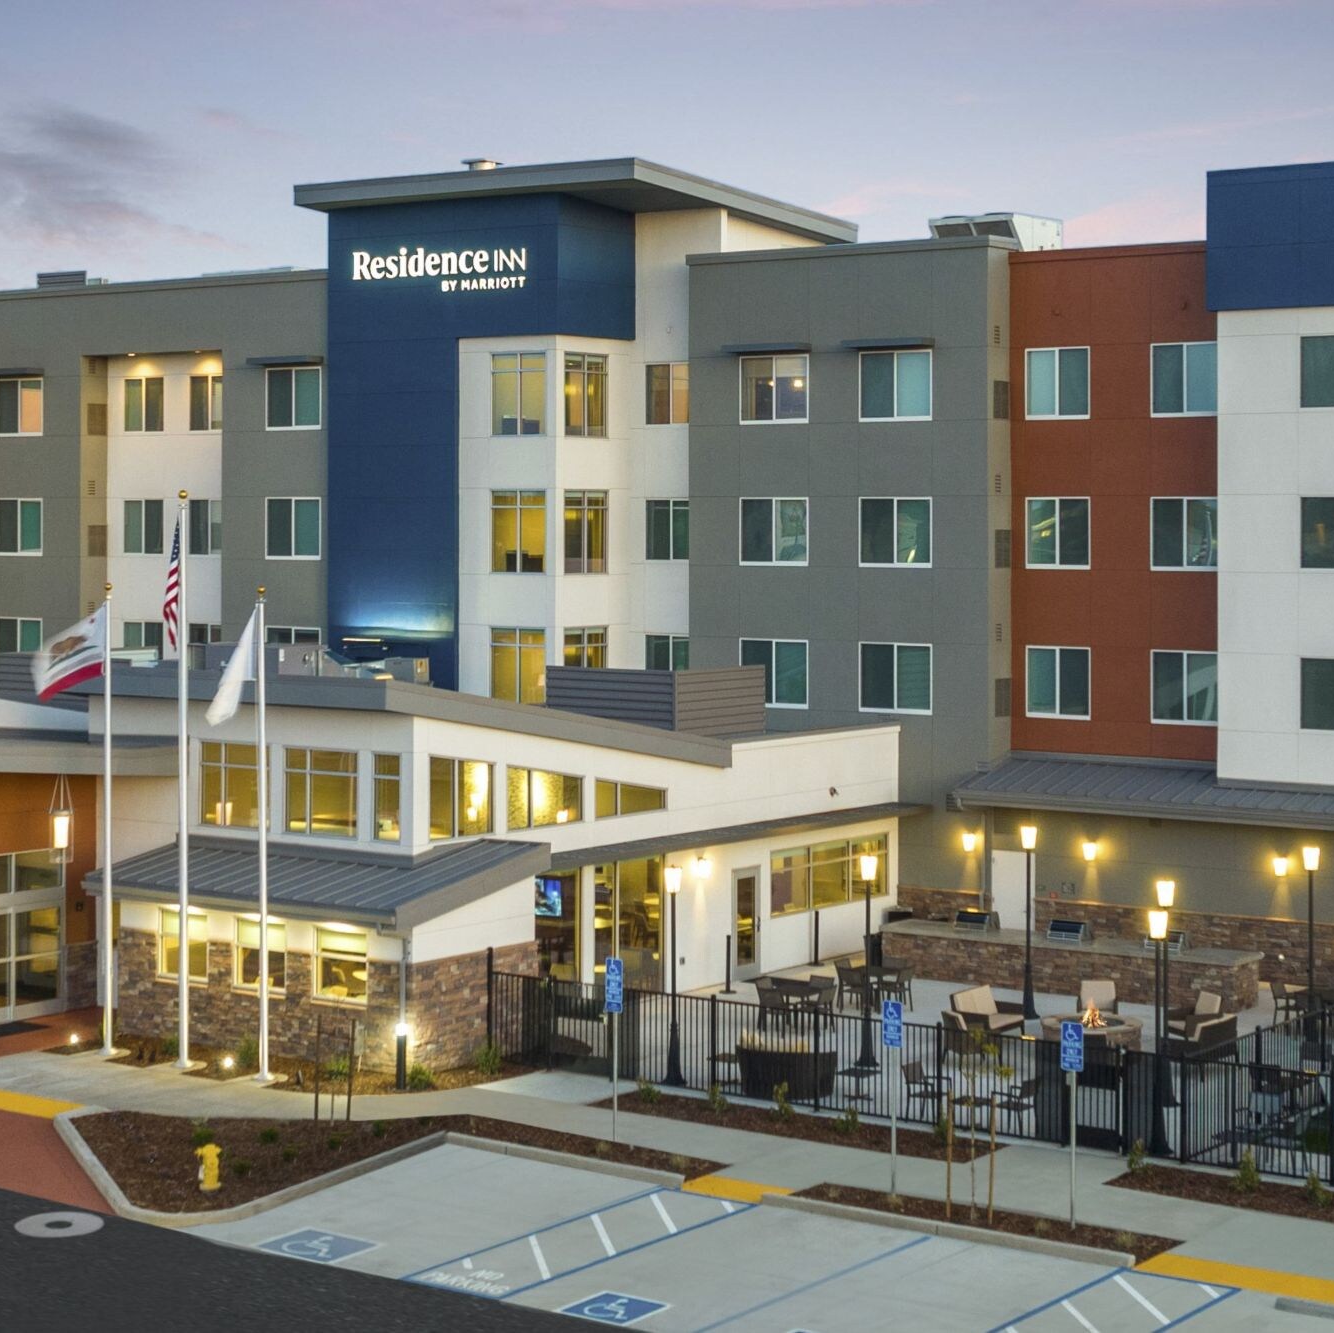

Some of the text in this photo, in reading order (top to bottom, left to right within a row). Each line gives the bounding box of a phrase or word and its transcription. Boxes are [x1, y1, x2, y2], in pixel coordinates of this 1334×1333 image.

[352, 247, 527, 281] Residence INN
[441, 276, 527, 292] BY MARRIOTT
